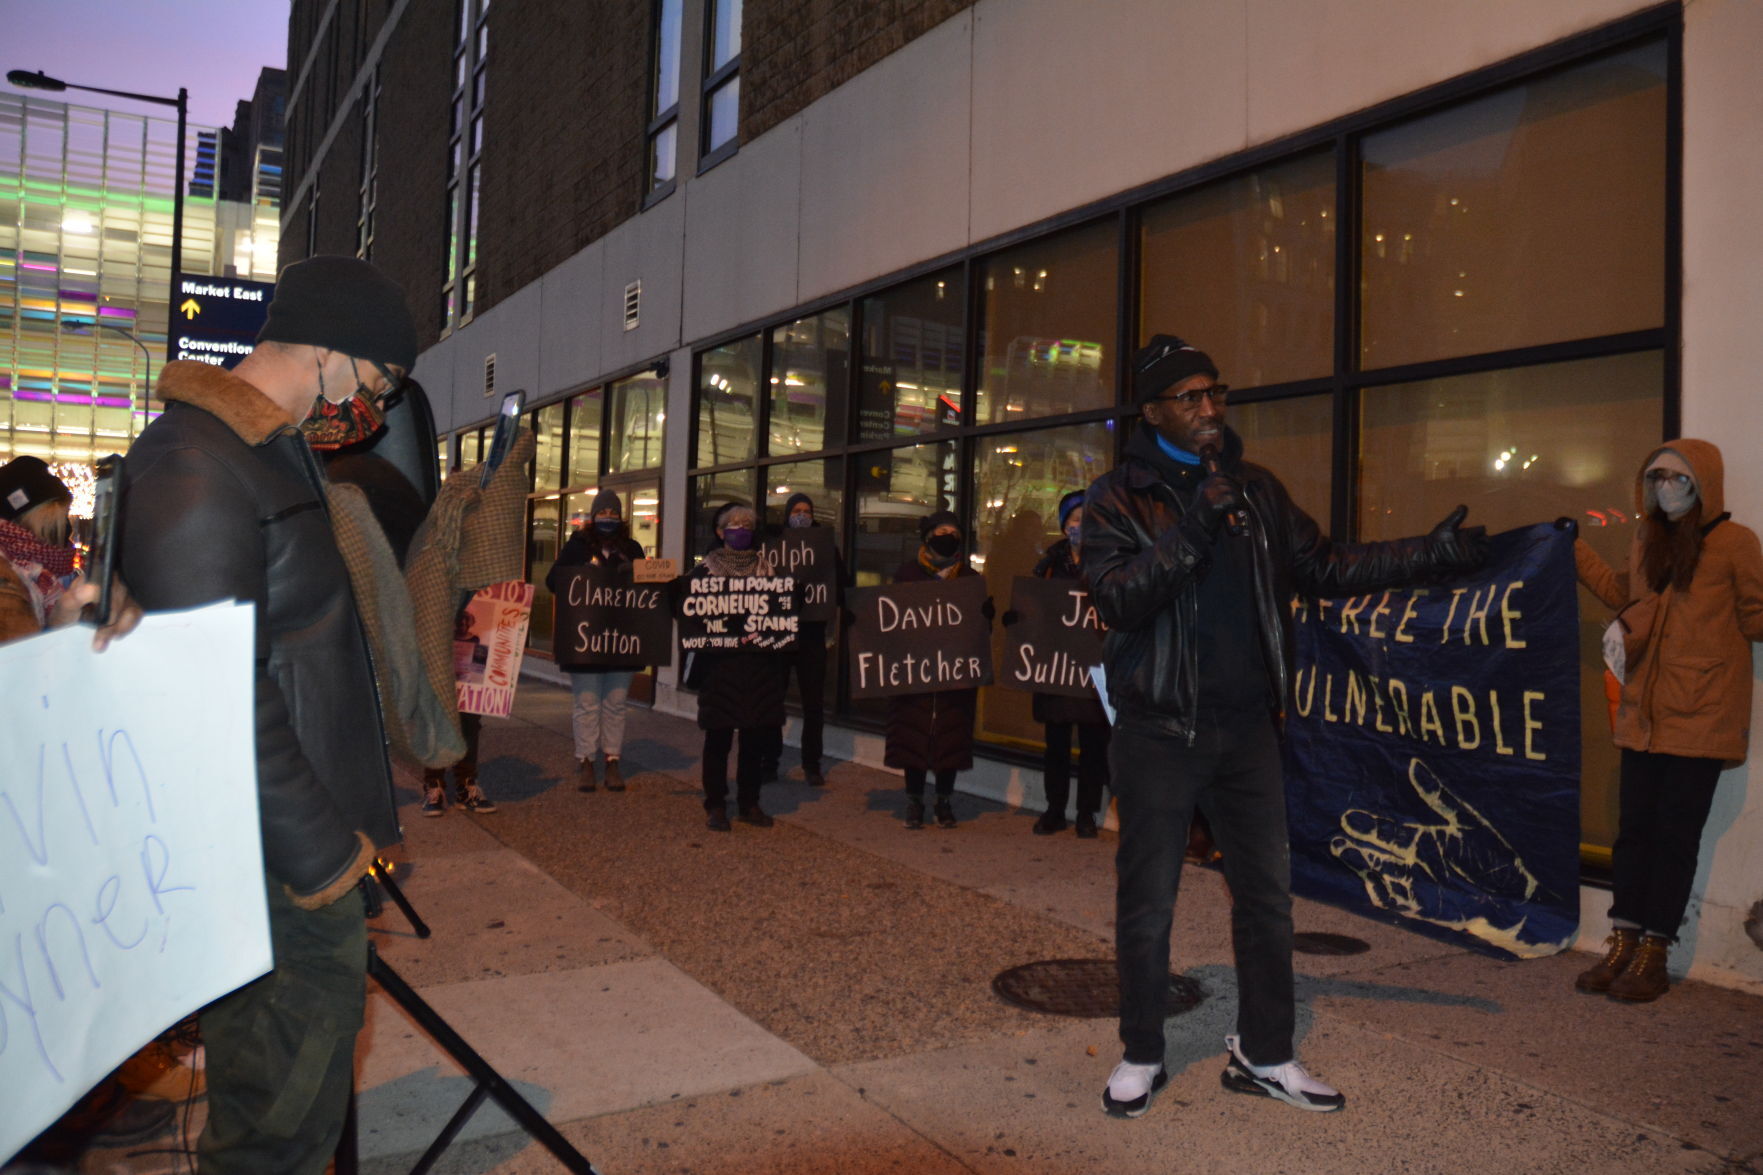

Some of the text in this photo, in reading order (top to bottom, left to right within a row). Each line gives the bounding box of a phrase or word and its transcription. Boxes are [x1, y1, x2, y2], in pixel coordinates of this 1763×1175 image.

[182, 281, 263, 301] Market East
[178, 336, 253, 354] Convention
[691, 577, 794, 593] REST IN POWER
[682, 594, 769, 616] CORNELIUS
[1441, 581, 1526, 648] THE
[744, 615, 798, 632] STAINE
[574, 621, 640, 654] Sutton
[1015, 643, 1095, 688] Sulliv
